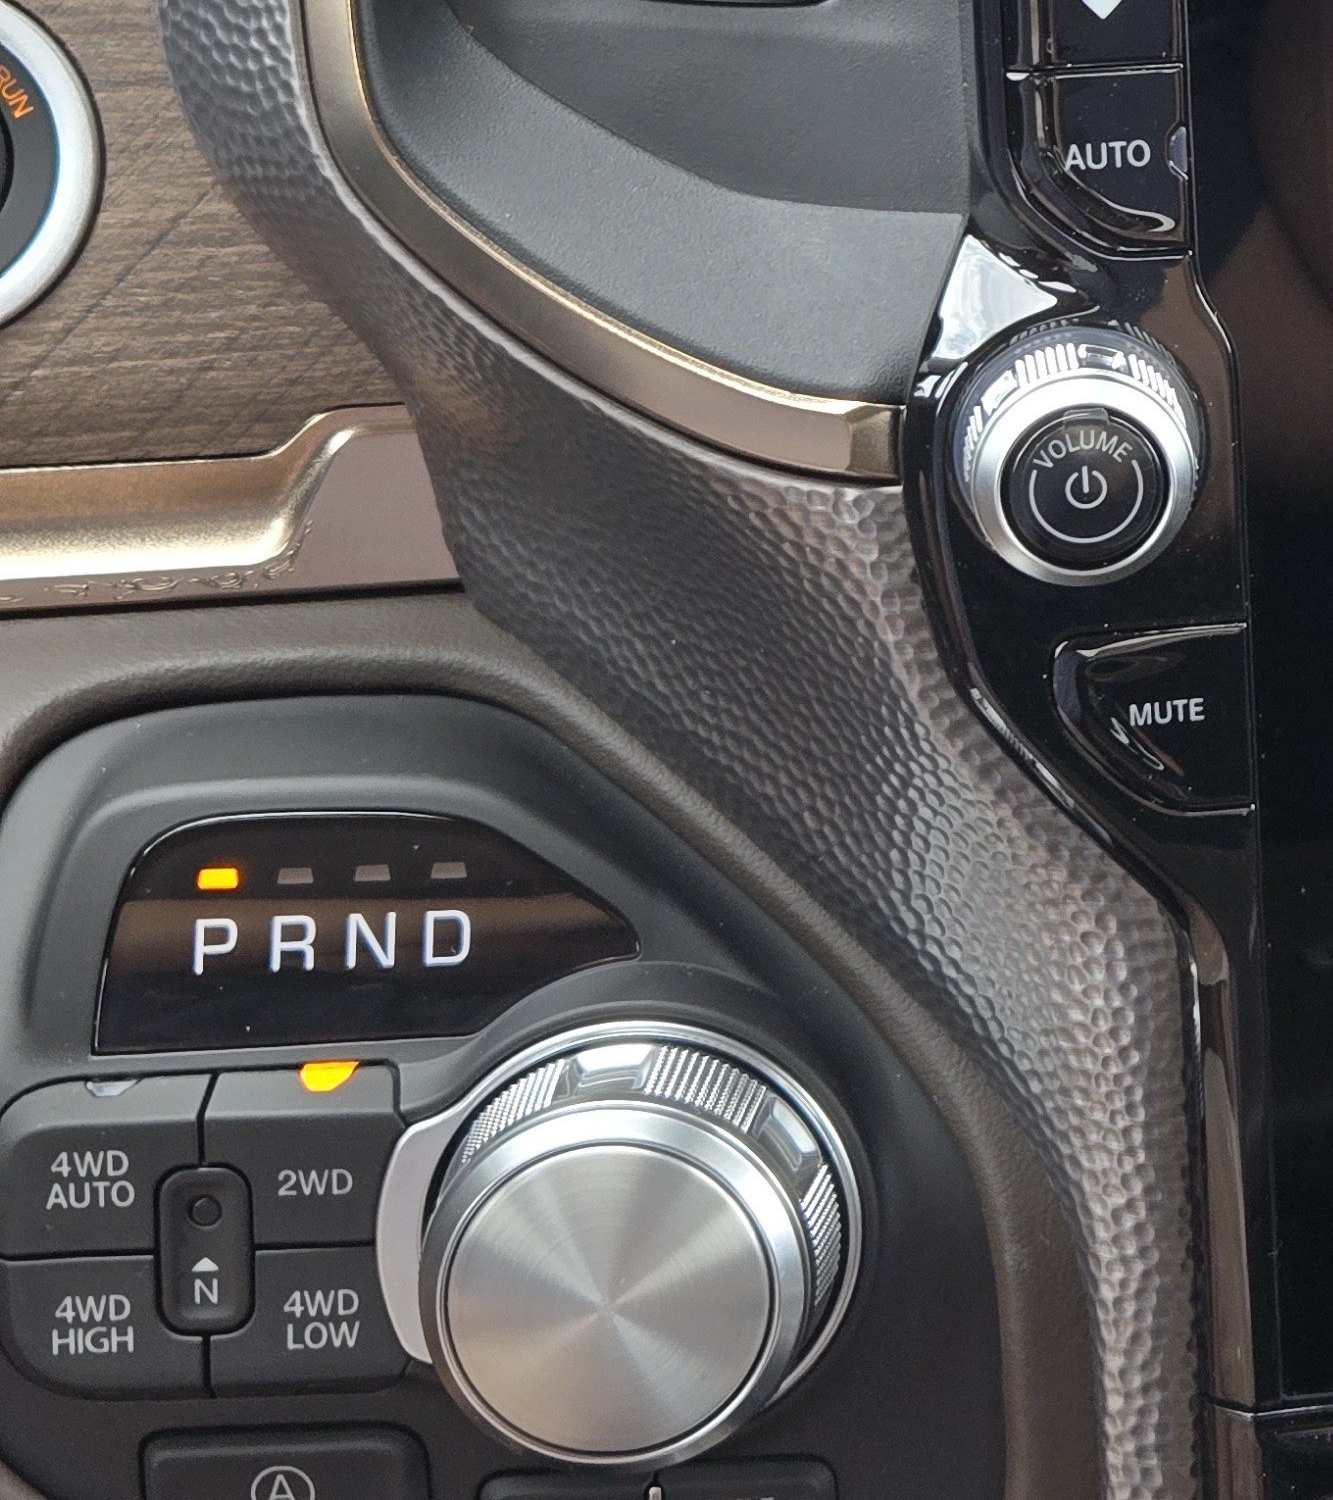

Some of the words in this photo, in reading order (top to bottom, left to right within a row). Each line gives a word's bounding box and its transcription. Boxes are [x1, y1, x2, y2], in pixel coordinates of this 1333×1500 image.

[1064, 140, 1152, 171] AUTO
[1033, 430, 1133, 469] VOLUME
[1129, 697, 1205, 727] MUTE
[193, 917, 238, 974] P
[269, 914, 316, 971] R
[345, 911, 397, 968] N
[422, 908, 472, 967] D
[50, 1148, 130, 1177] 4WD
[45, 1178, 135, 1209] AUTO
[277, 1168, 353, 1198] 2WD
[194, 1278, 219, 1305] N
[283, 1289, 360, 1319] 4WD
[54, 1295, 131, 1322] 4WD
[52, 1324, 134, 1355] HIGH
[286, 1320, 360, 1350] LOW
